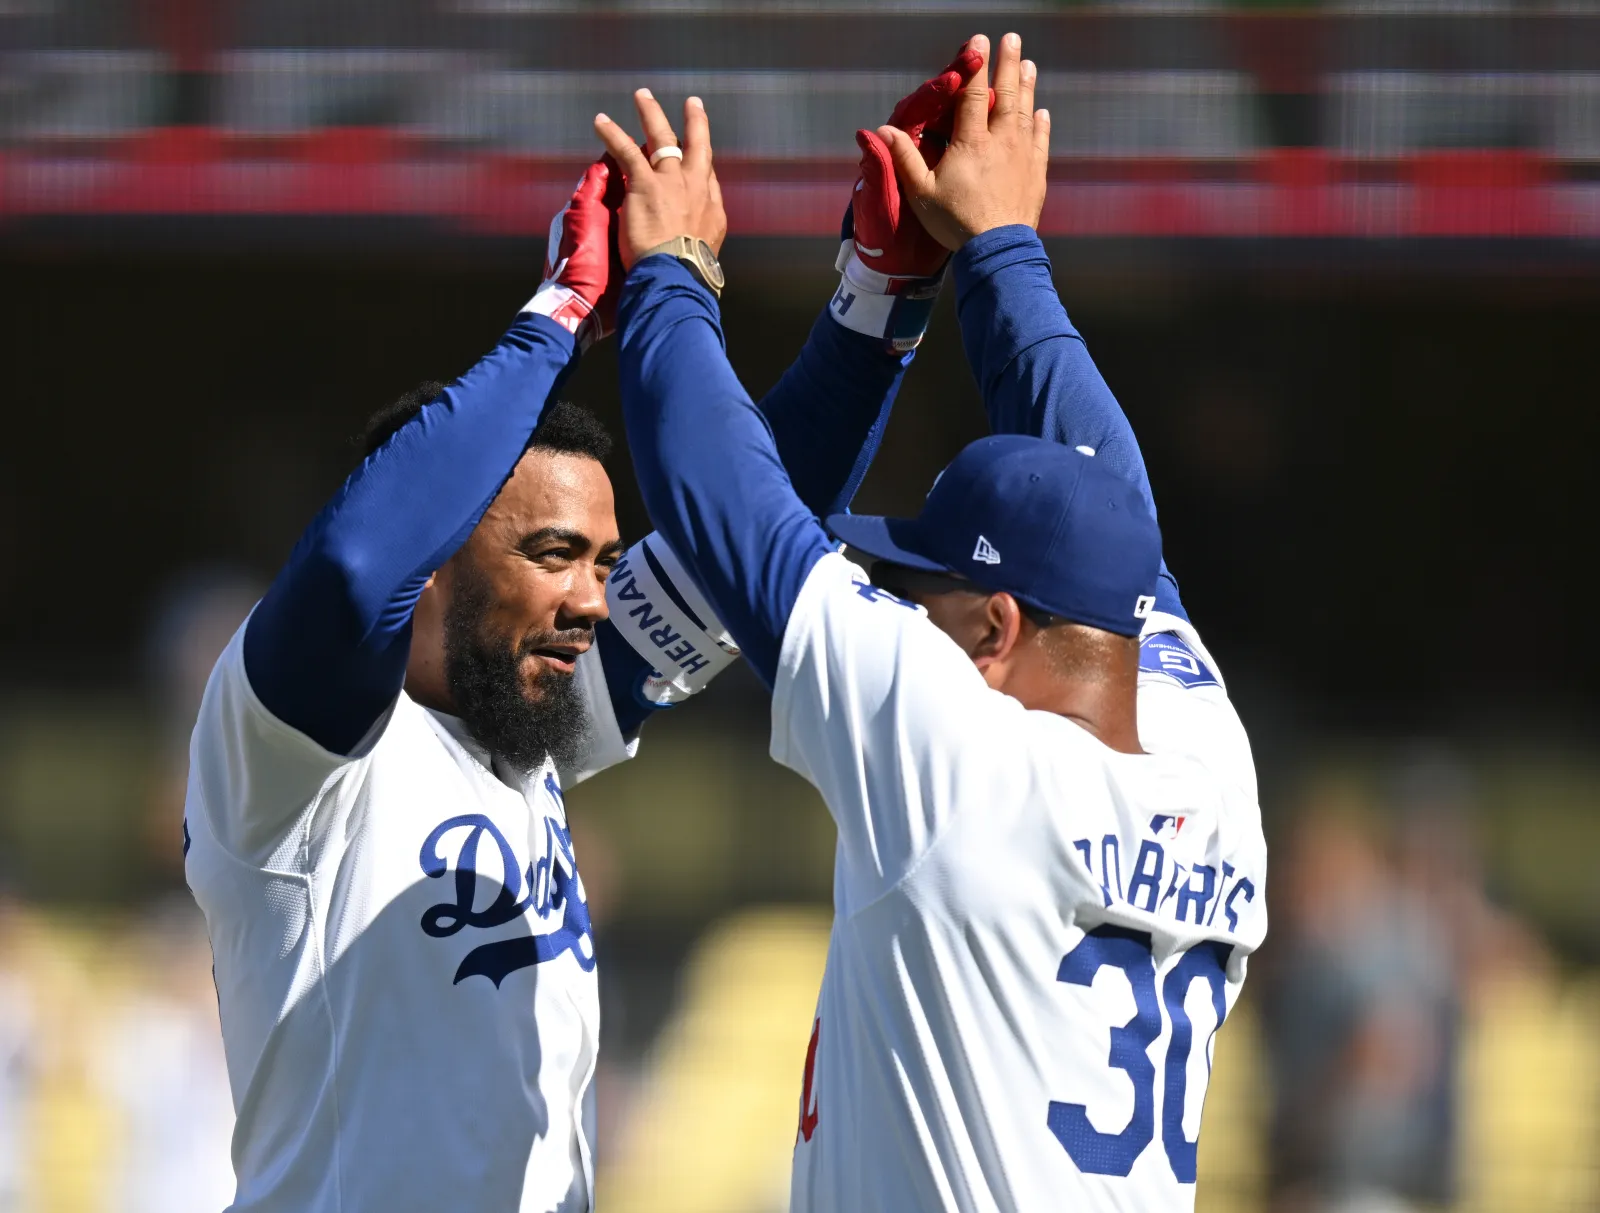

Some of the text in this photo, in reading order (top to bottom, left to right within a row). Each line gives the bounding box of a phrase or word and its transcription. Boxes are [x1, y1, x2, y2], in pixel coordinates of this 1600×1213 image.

[610, 552, 711, 676] HERNAN
[1158, 650, 1201, 676] G
[1046, 921, 1236, 1184] 30
